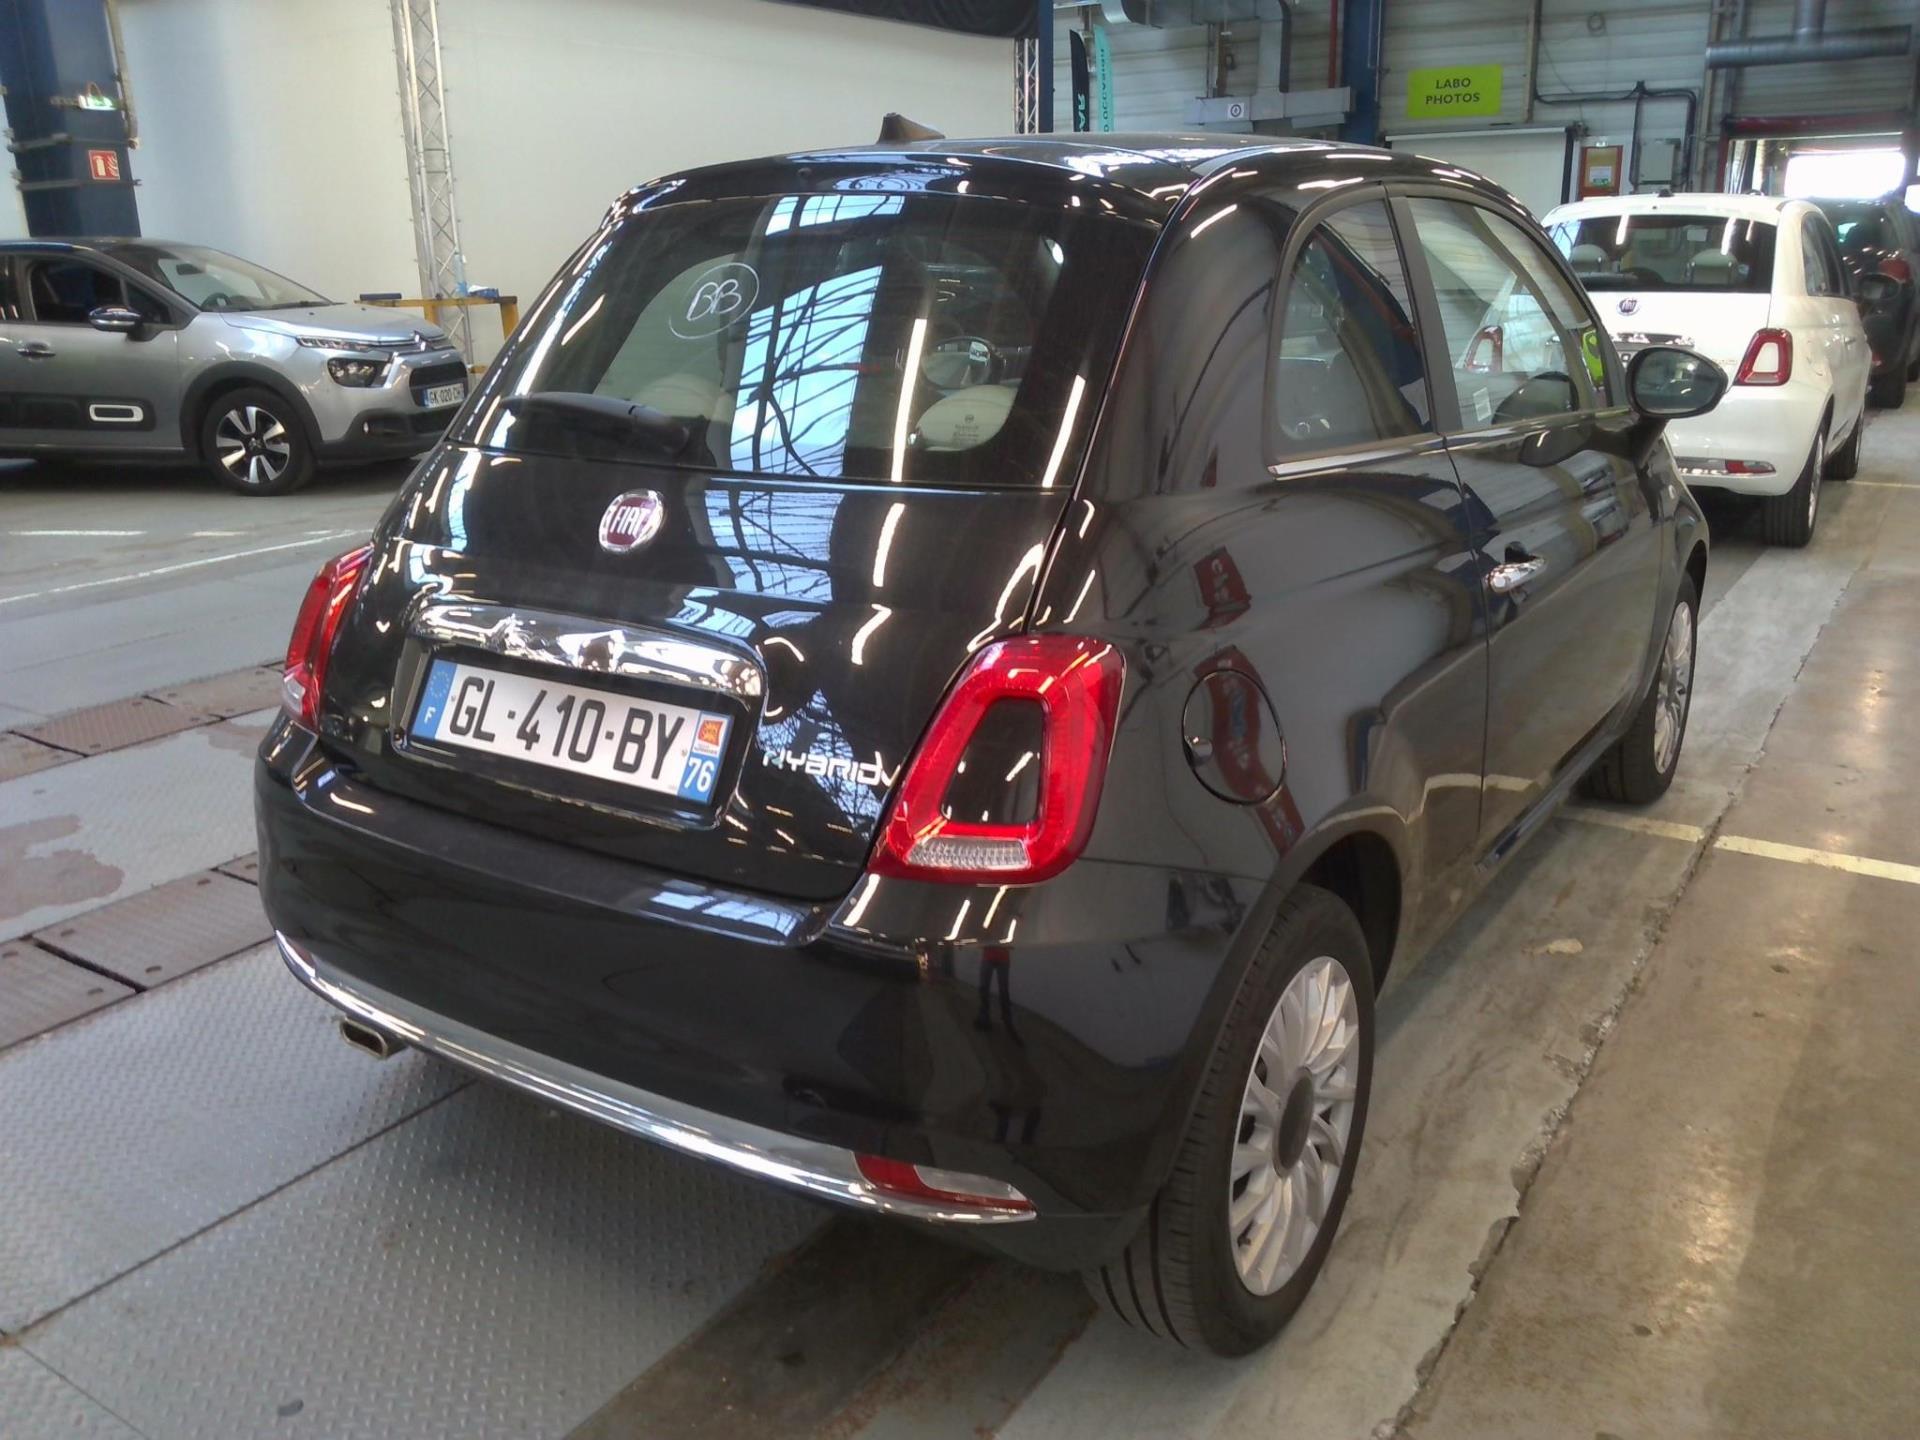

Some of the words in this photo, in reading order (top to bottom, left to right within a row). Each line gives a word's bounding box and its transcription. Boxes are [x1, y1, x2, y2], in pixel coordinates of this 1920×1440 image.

[1435, 77, 1471, 90] LABO
[1425, 92, 1480, 105] PHOTOS
[609, 505, 652, 538] FIAT
[424, 706, 436, 724] F
[684, 757, 716, 793] 76
